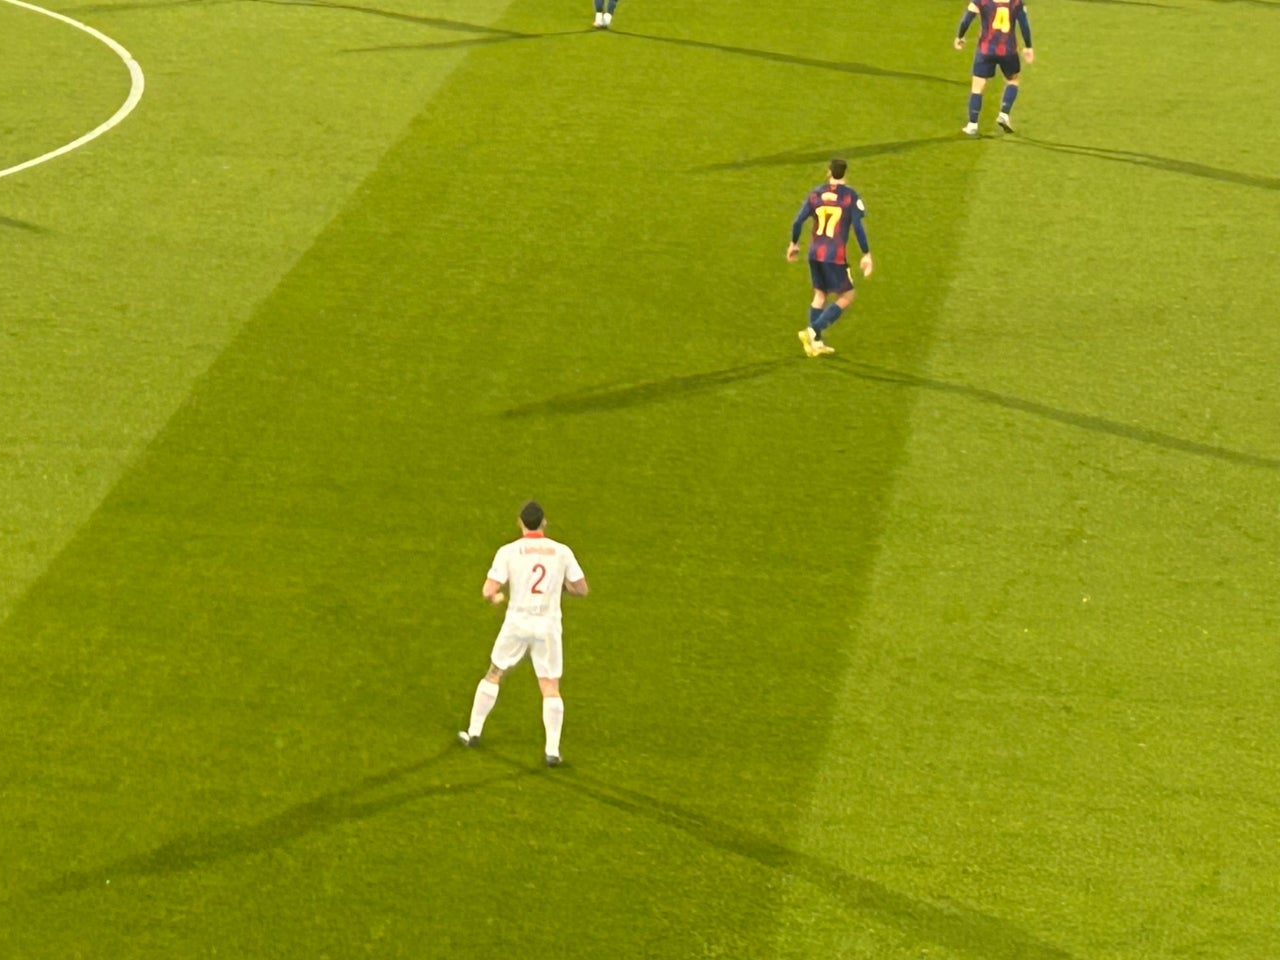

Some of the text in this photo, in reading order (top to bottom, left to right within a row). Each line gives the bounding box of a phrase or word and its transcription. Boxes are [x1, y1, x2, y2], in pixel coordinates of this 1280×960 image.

[992, 7, 1011, 33] 4
[815, 205, 843, 238] 17
[531, 564, 546, 594] 2
